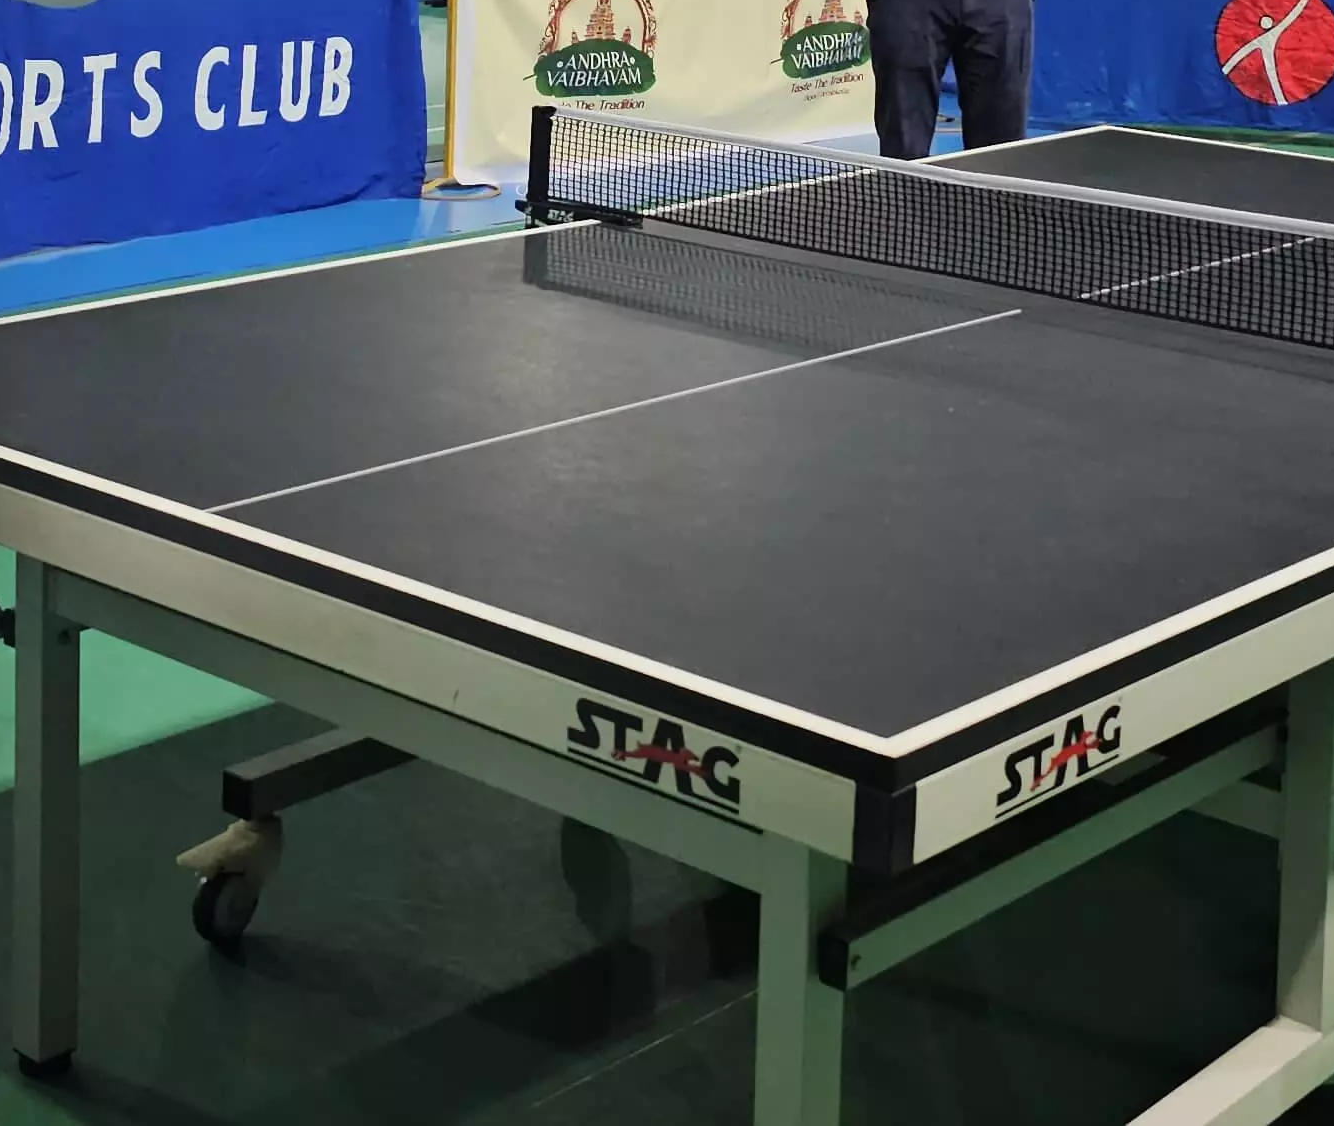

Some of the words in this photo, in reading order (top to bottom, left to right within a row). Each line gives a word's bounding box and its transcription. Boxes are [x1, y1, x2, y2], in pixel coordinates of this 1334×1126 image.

[802, 31, 860, 52] ANDHRA
[564, 50, 631, 71] ANDHRA
[193, 36, 354, 131] CLUB
[547, 67, 642, 88] VAIBHAVAM
[791, 82, 813, 94] Taste
[815, 78, 828, 90] The
[575, 99, 595, 111] The
[599, 97, 645, 112] Tradition
[567, 696, 742, 816] STAG
[995, 704, 1122, 819] STAG
